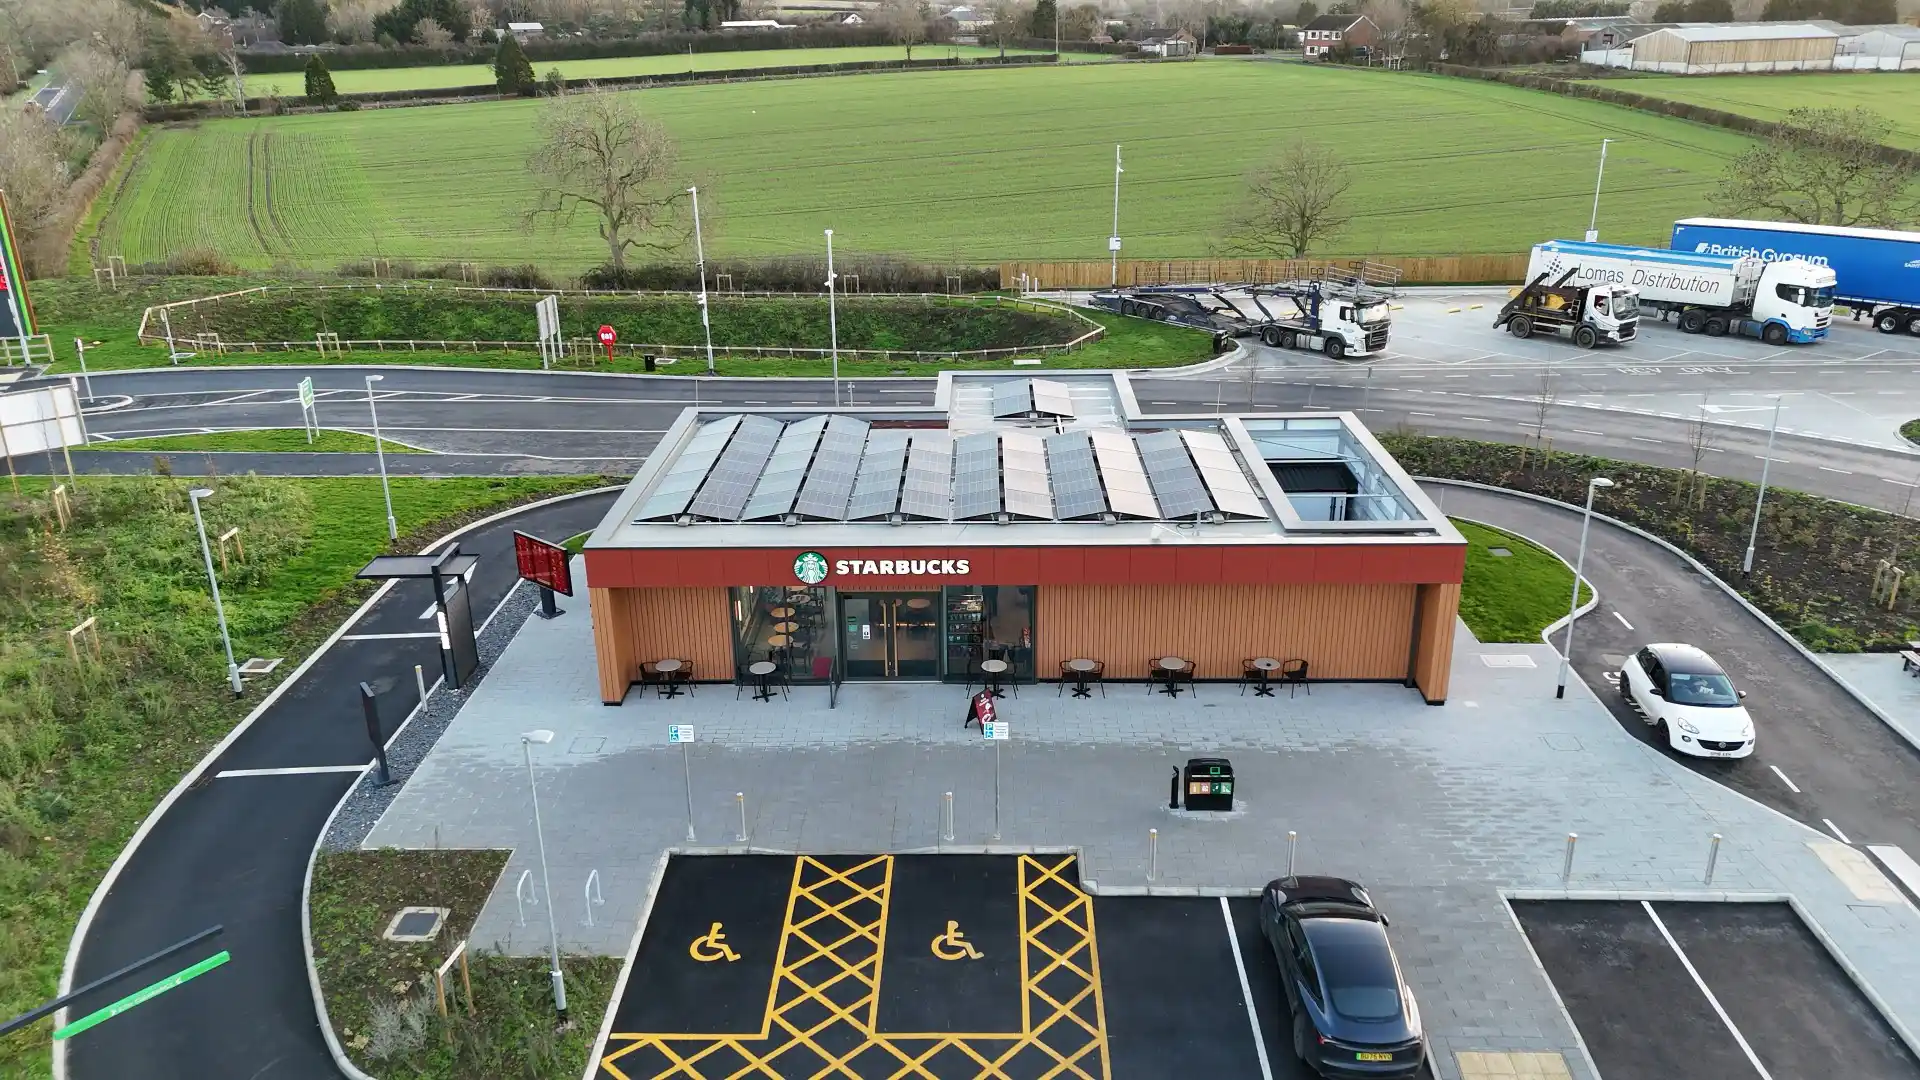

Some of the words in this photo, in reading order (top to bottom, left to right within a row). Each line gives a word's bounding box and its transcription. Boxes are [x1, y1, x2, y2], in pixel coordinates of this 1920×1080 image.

[1710, 244, 1760, 260] British
[1577, 263, 1624, 283] Lomas
[1632, 269, 1720, 294] Distribution
[835, 559, 970, 575] STARBUCKS
